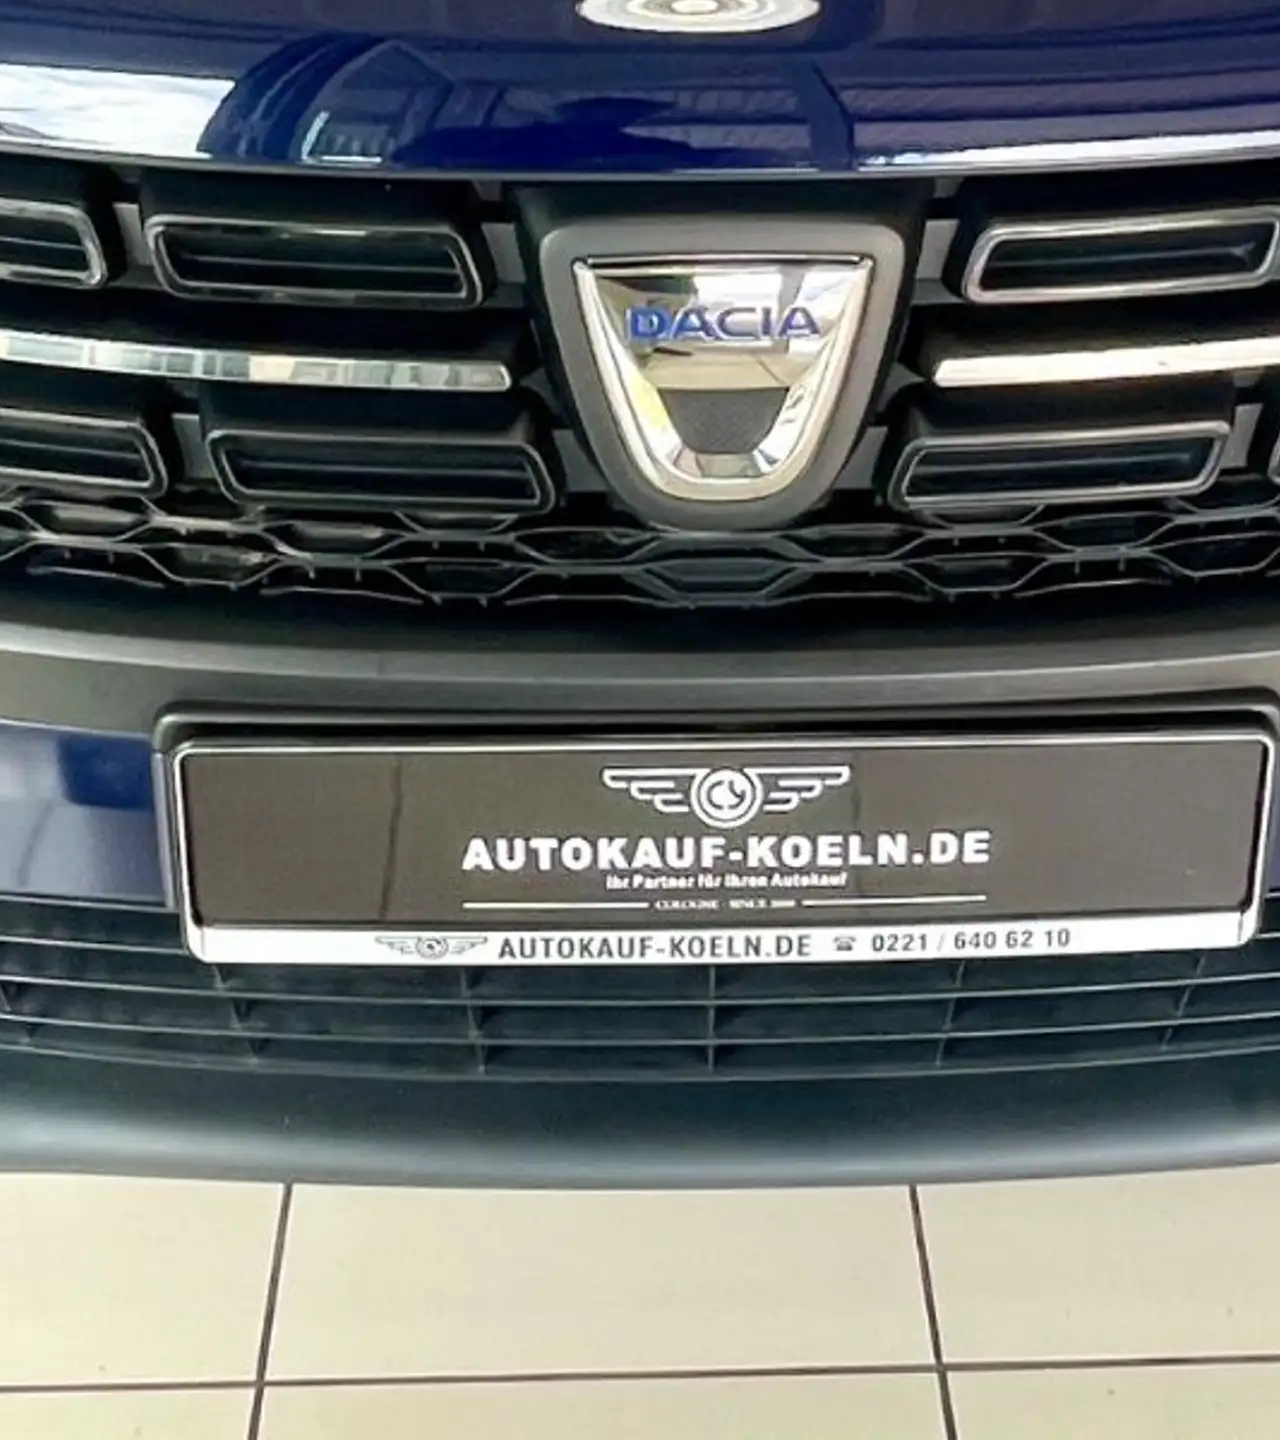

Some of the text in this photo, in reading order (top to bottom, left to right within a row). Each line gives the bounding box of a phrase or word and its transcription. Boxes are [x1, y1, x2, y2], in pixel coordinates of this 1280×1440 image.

[628, 306, 820, 340] DACIA
[462, 830, 992, 871] AUTOKAUF-KOELN.DE
[633, 873, 695, 890] Partner
[724, 872, 768, 888] Ihren
[771, 871, 849, 888] Autokauf
[498, 934, 812, 959] AUTOKAUF-KOELN.DE
[871, 933, 928, 953] 0221
[954, 931, 997, 950] 640
[1005, 930, 1034, 949] 62
[1045, 928, 1070, 948] 10
